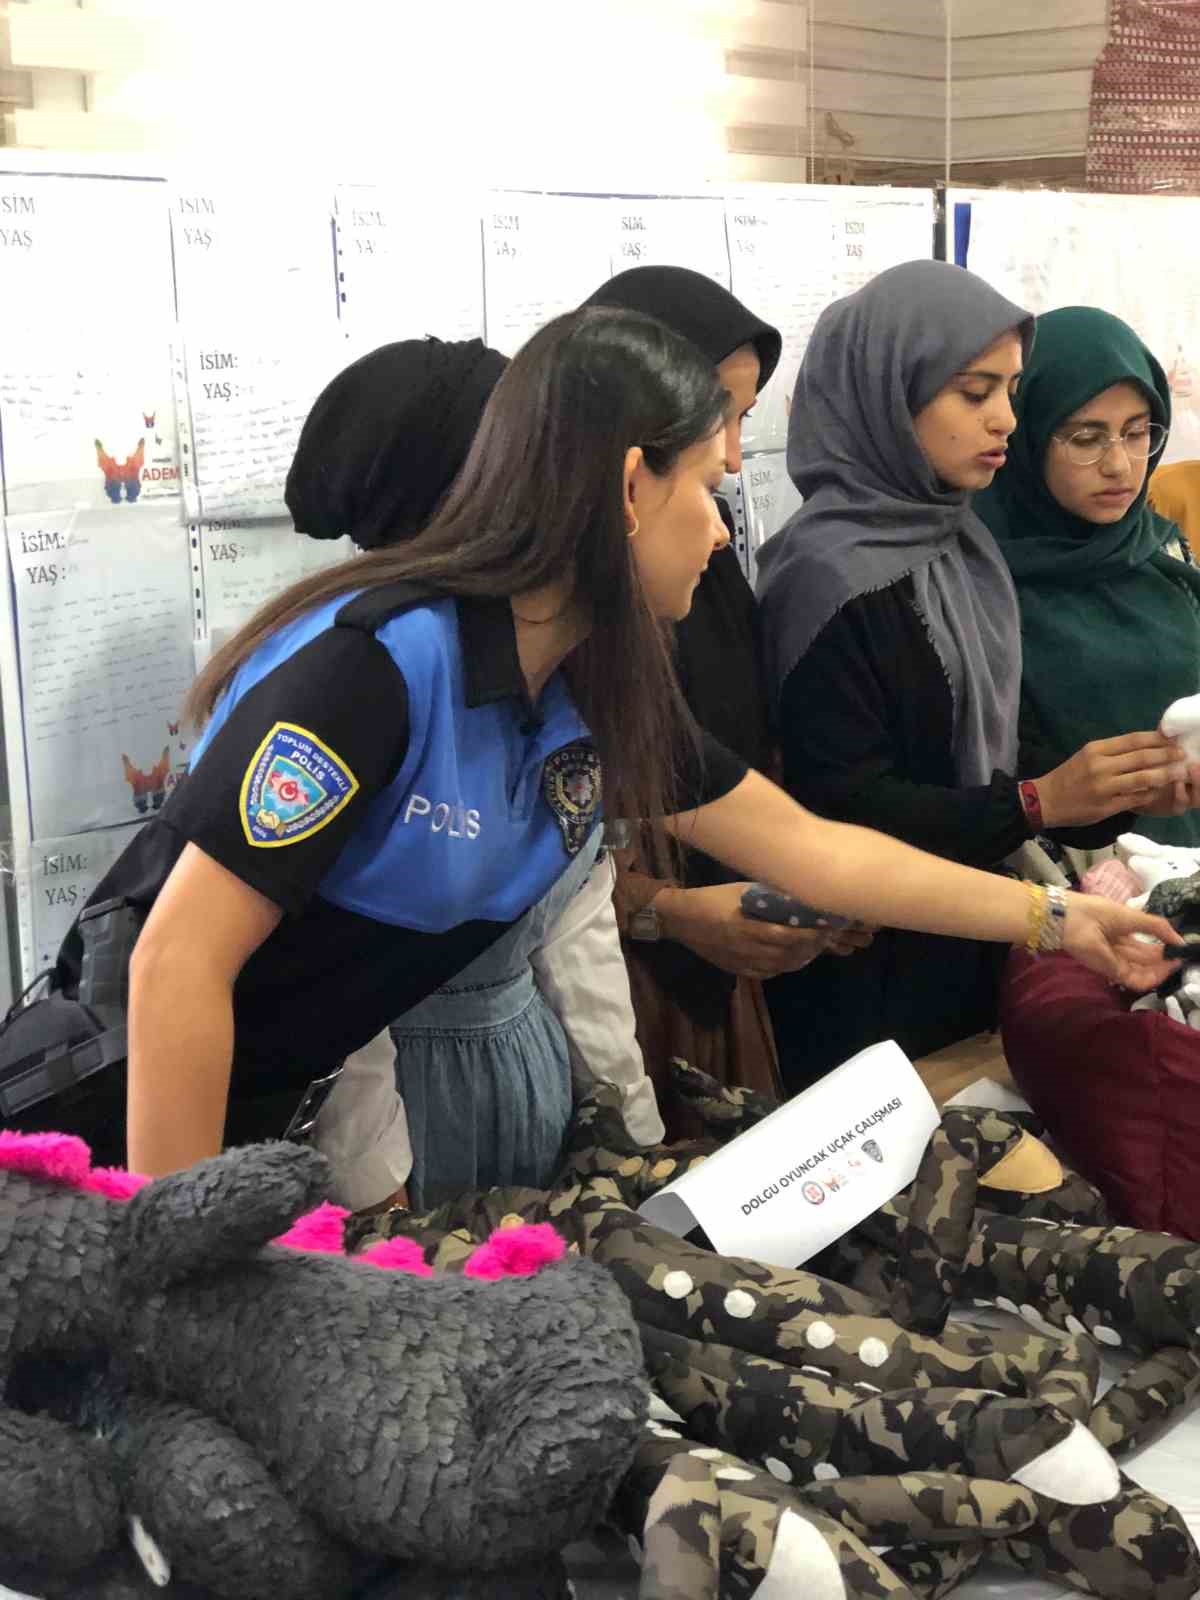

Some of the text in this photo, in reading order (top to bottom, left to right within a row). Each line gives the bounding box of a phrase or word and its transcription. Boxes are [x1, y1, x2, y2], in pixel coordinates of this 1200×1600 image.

[142, 466, 180, 482] ADEM
[741, 1183, 780, 1216] DOLGU
[779, 1148, 830, 1188] OYUNCAK
[826, 1129, 857, 1154] UÇAK
[855, 1097, 903, 1135] ÇALIŞMASI
